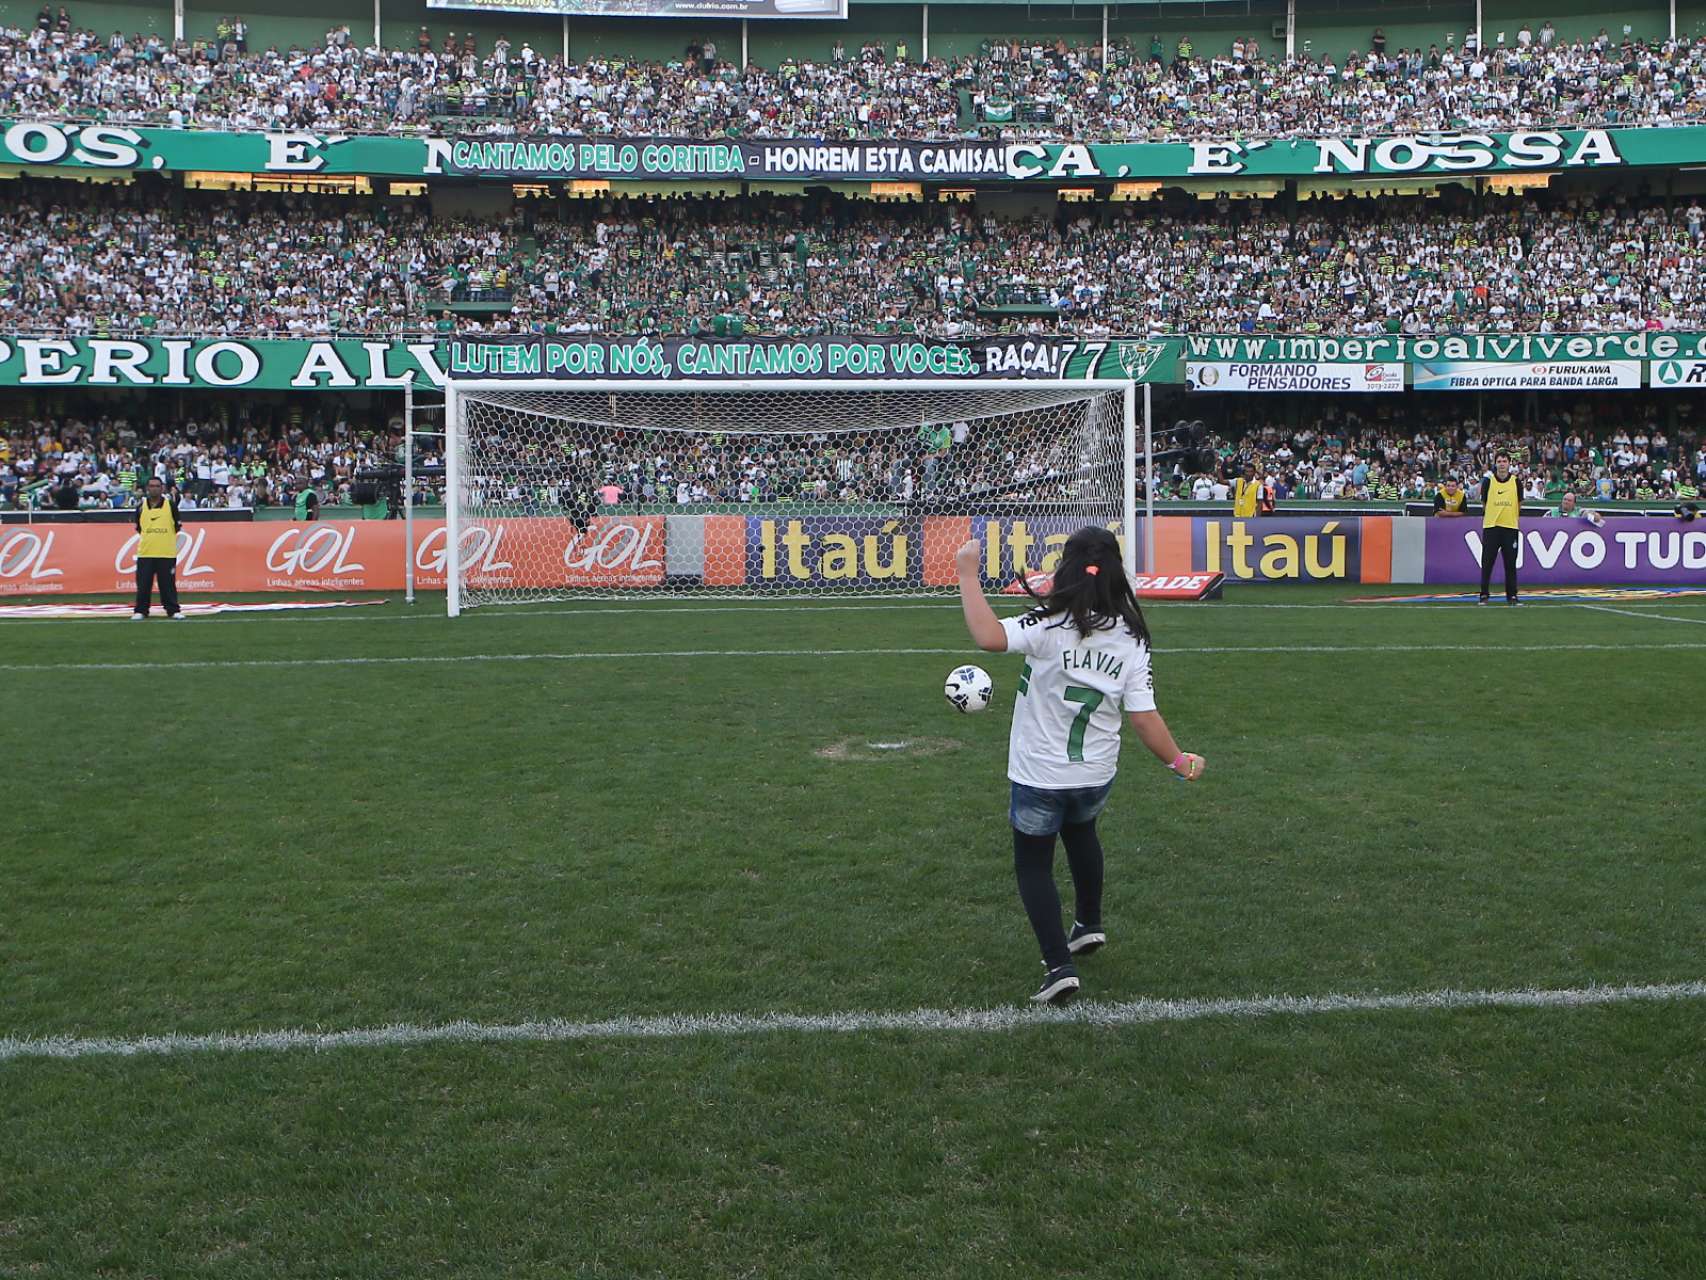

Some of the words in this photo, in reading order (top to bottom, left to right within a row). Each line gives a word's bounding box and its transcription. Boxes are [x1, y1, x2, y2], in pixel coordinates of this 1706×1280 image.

[453, 140, 576, 172] CANTAMOS
[579, 143, 637, 172] PELO
[642, 144, 745, 173] CORITIBA
[765, 147, 859, 173] HONREM
[865, 147, 914, 173] ESTA
[918, 148, 1005, 174] CAMISA!
[0, 338, 260, 386] ERIO
[451, 341, 541, 374] LUTEM
[546, 342, 605, 374] POR
[609, 336, 673, 378] NÓS,
[677, 342, 822, 374] CANTAMOS
[828, 343, 886, 374] POR
[985, 341, 1059, 376] RAÇA!
[1228, 363, 1318, 377] FORMANDO
[1449, 377, 1479, 388] FIBRA
[1519, 376, 1546, 387] PARA
[1549, 376, 1583, 387] BANDA
[1586, 374, 1618, 386] LARGA
[1548, 365, 1611, 375] FURUKAWA
[1247, 376, 1351, 391] PENSADORES
[0, 530, 64, 579] OL
[266, 525, 365, 576] GOL
[563, 522, 661, 572] GOL
[761, 520, 908, 579] Itaú
[987, 520, 1125, 579] Ita
[1206, 520, 1346, 579] Itaú
[1063, 649, 1124, 680] FLAVIA
[1064, 685, 1105, 762] 7
